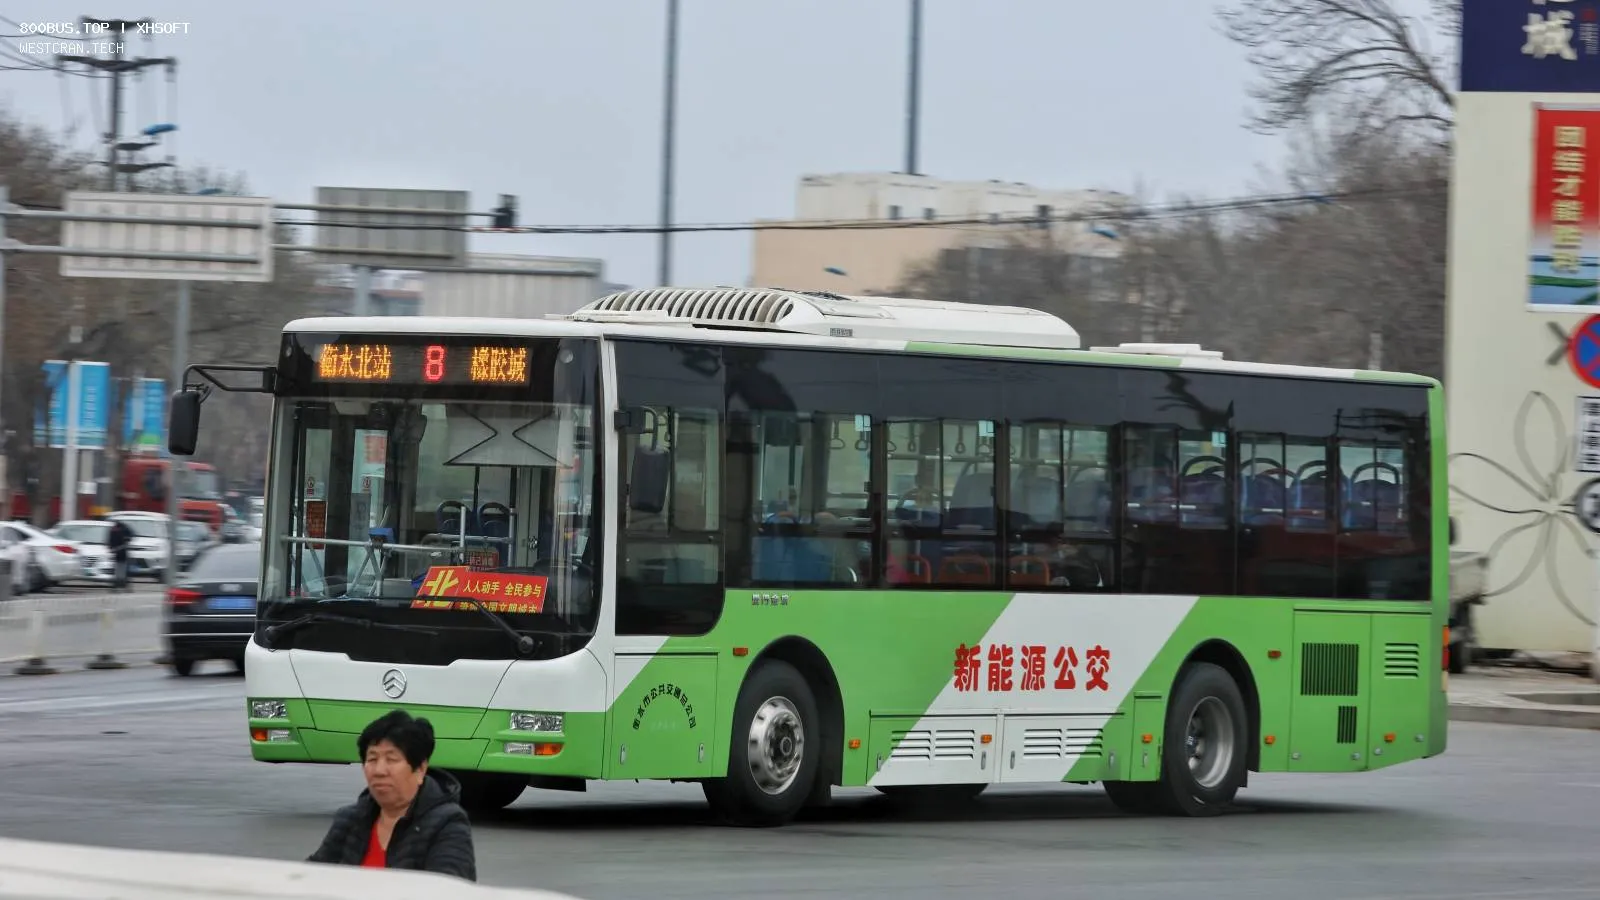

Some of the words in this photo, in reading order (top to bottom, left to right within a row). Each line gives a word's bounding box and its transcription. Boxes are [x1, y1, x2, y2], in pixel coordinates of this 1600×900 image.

[1520, 0, 1578, 61] 城
[318, 343, 392, 380] 衡水北站
[423, 344, 447, 383] 8
[470, 346, 528, 384] 橡胶城
[463, 579, 501, 596] 人人动手
[503, 582, 543, 598] 全民参与
[953, 643, 1111, 692] 新能源公交
